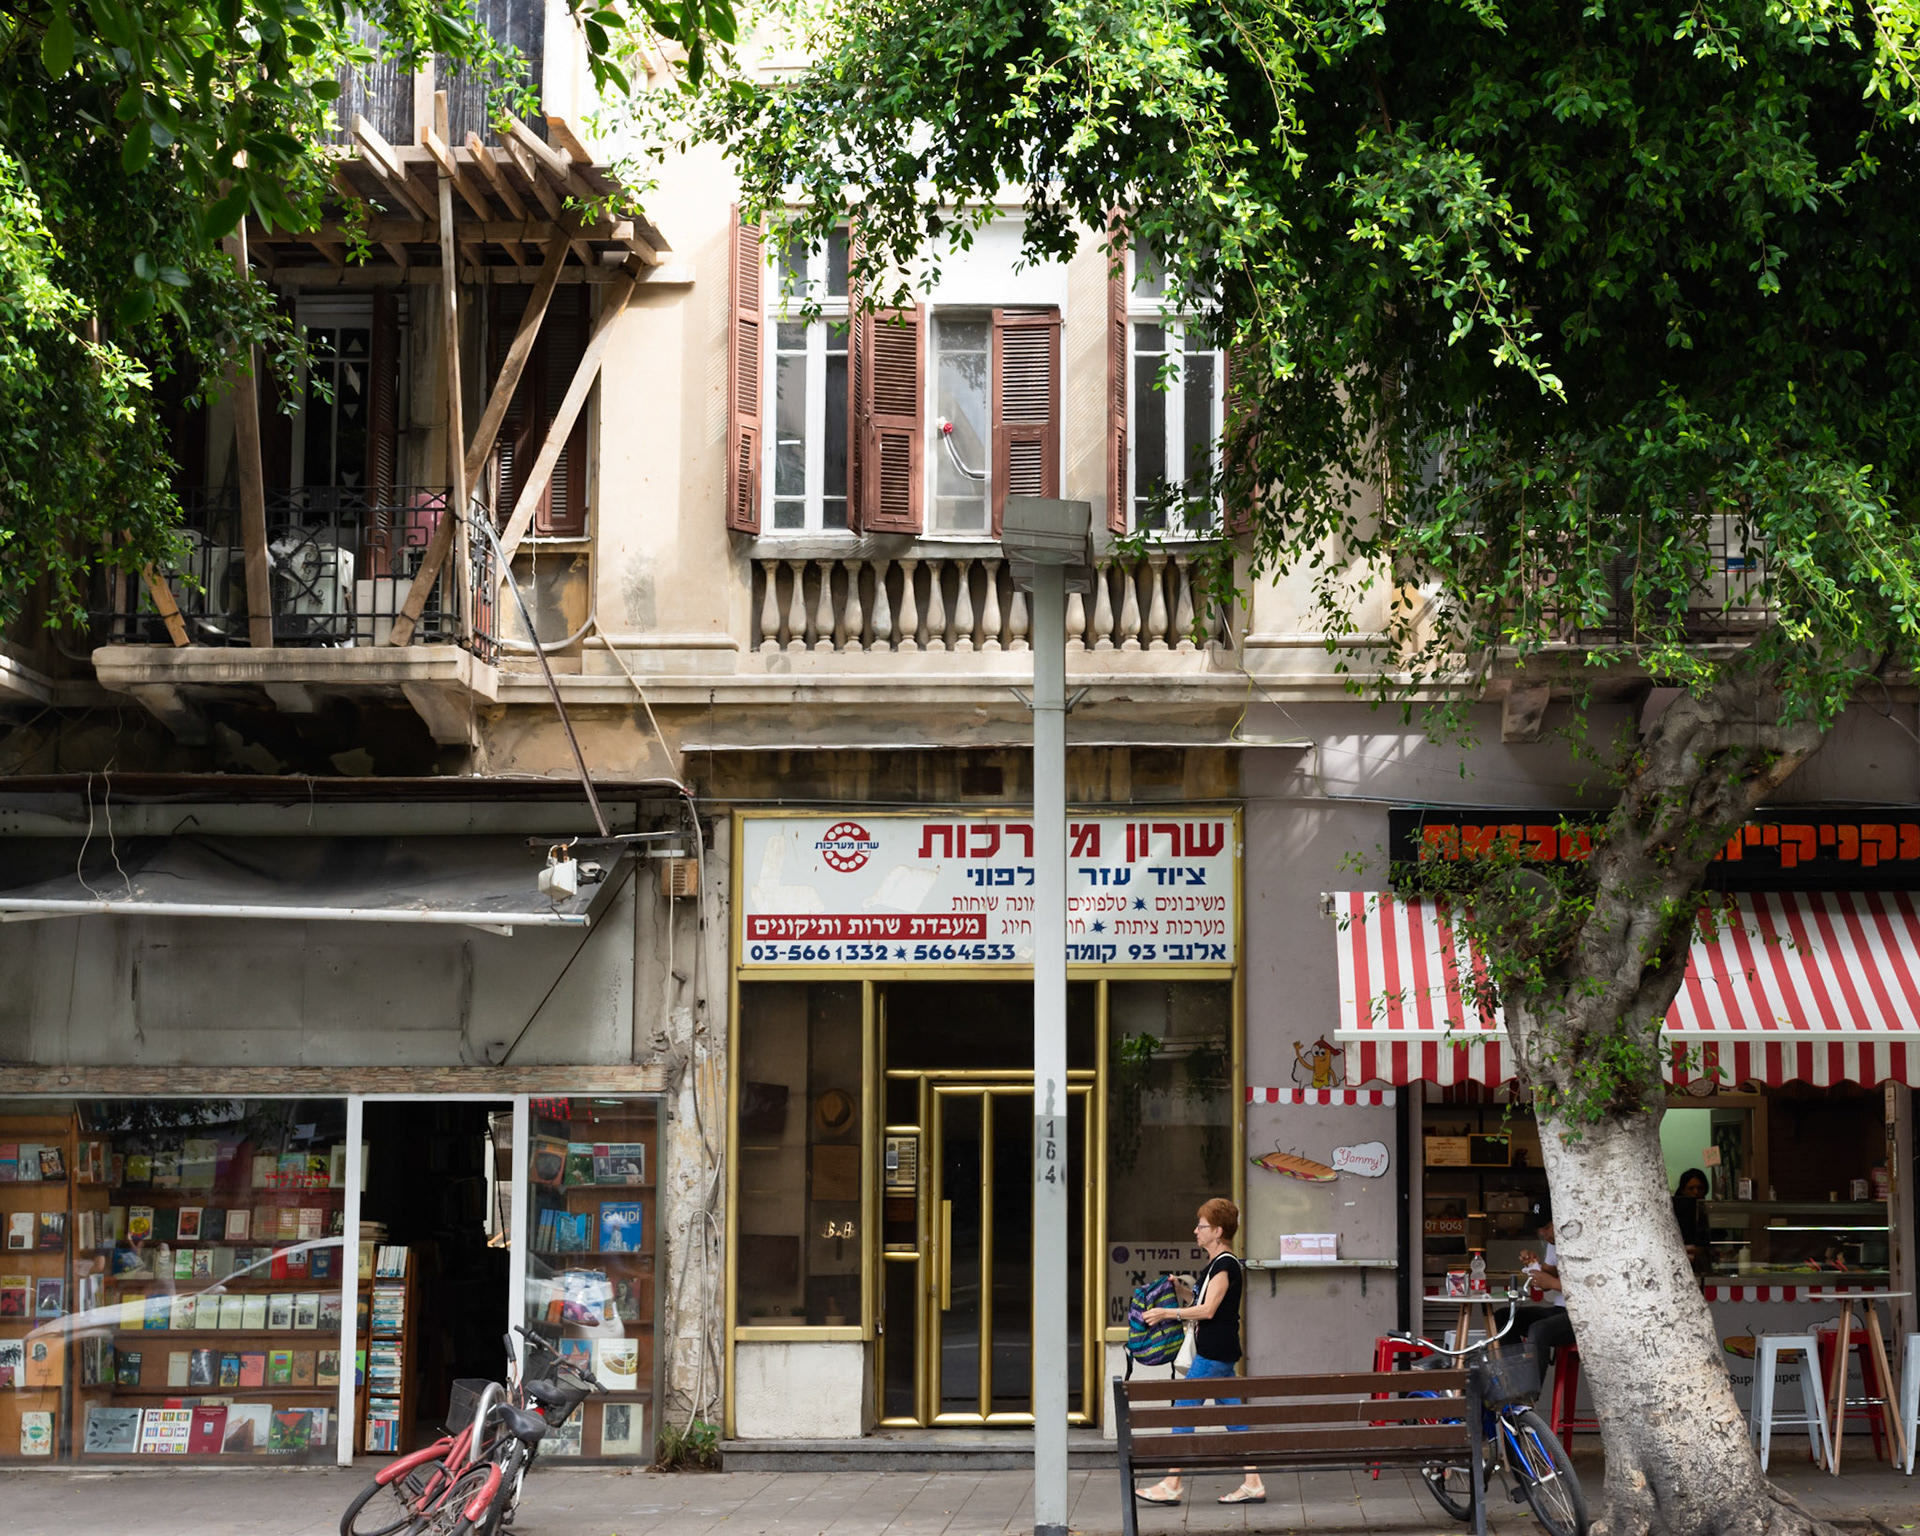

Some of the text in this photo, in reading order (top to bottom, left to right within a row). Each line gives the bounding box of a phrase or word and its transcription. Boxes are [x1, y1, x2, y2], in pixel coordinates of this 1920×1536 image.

[814, 841, 880, 851] שרון מערכות
[918, 823, 1224, 863] שרון מרכות
[966, 866, 1207, 887] ציוד עזר לפוני
[951, 895, 999, 912] שיחות
[1067, 892, 1127, 912] טלפונים
[1155, 896, 1226, 912] משיבונים
[754, 917, 980, 940] מעבדת שרות ותיקונים
[1001, 919, 1032, 935] חיוג
[1113, 919, 1159, 935] ציתות
[1165, 919, 1226, 938] מערכות
[913, 944, 1016, 961] 5664533
[1066, 942, 1227, 964] אלנבי 93 קומה
[1424, 1220, 1463, 1231] OT DOGS
[1135, 1248, 1180, 1261] המדף
[1775, 1373, 1801, 1386] uper
